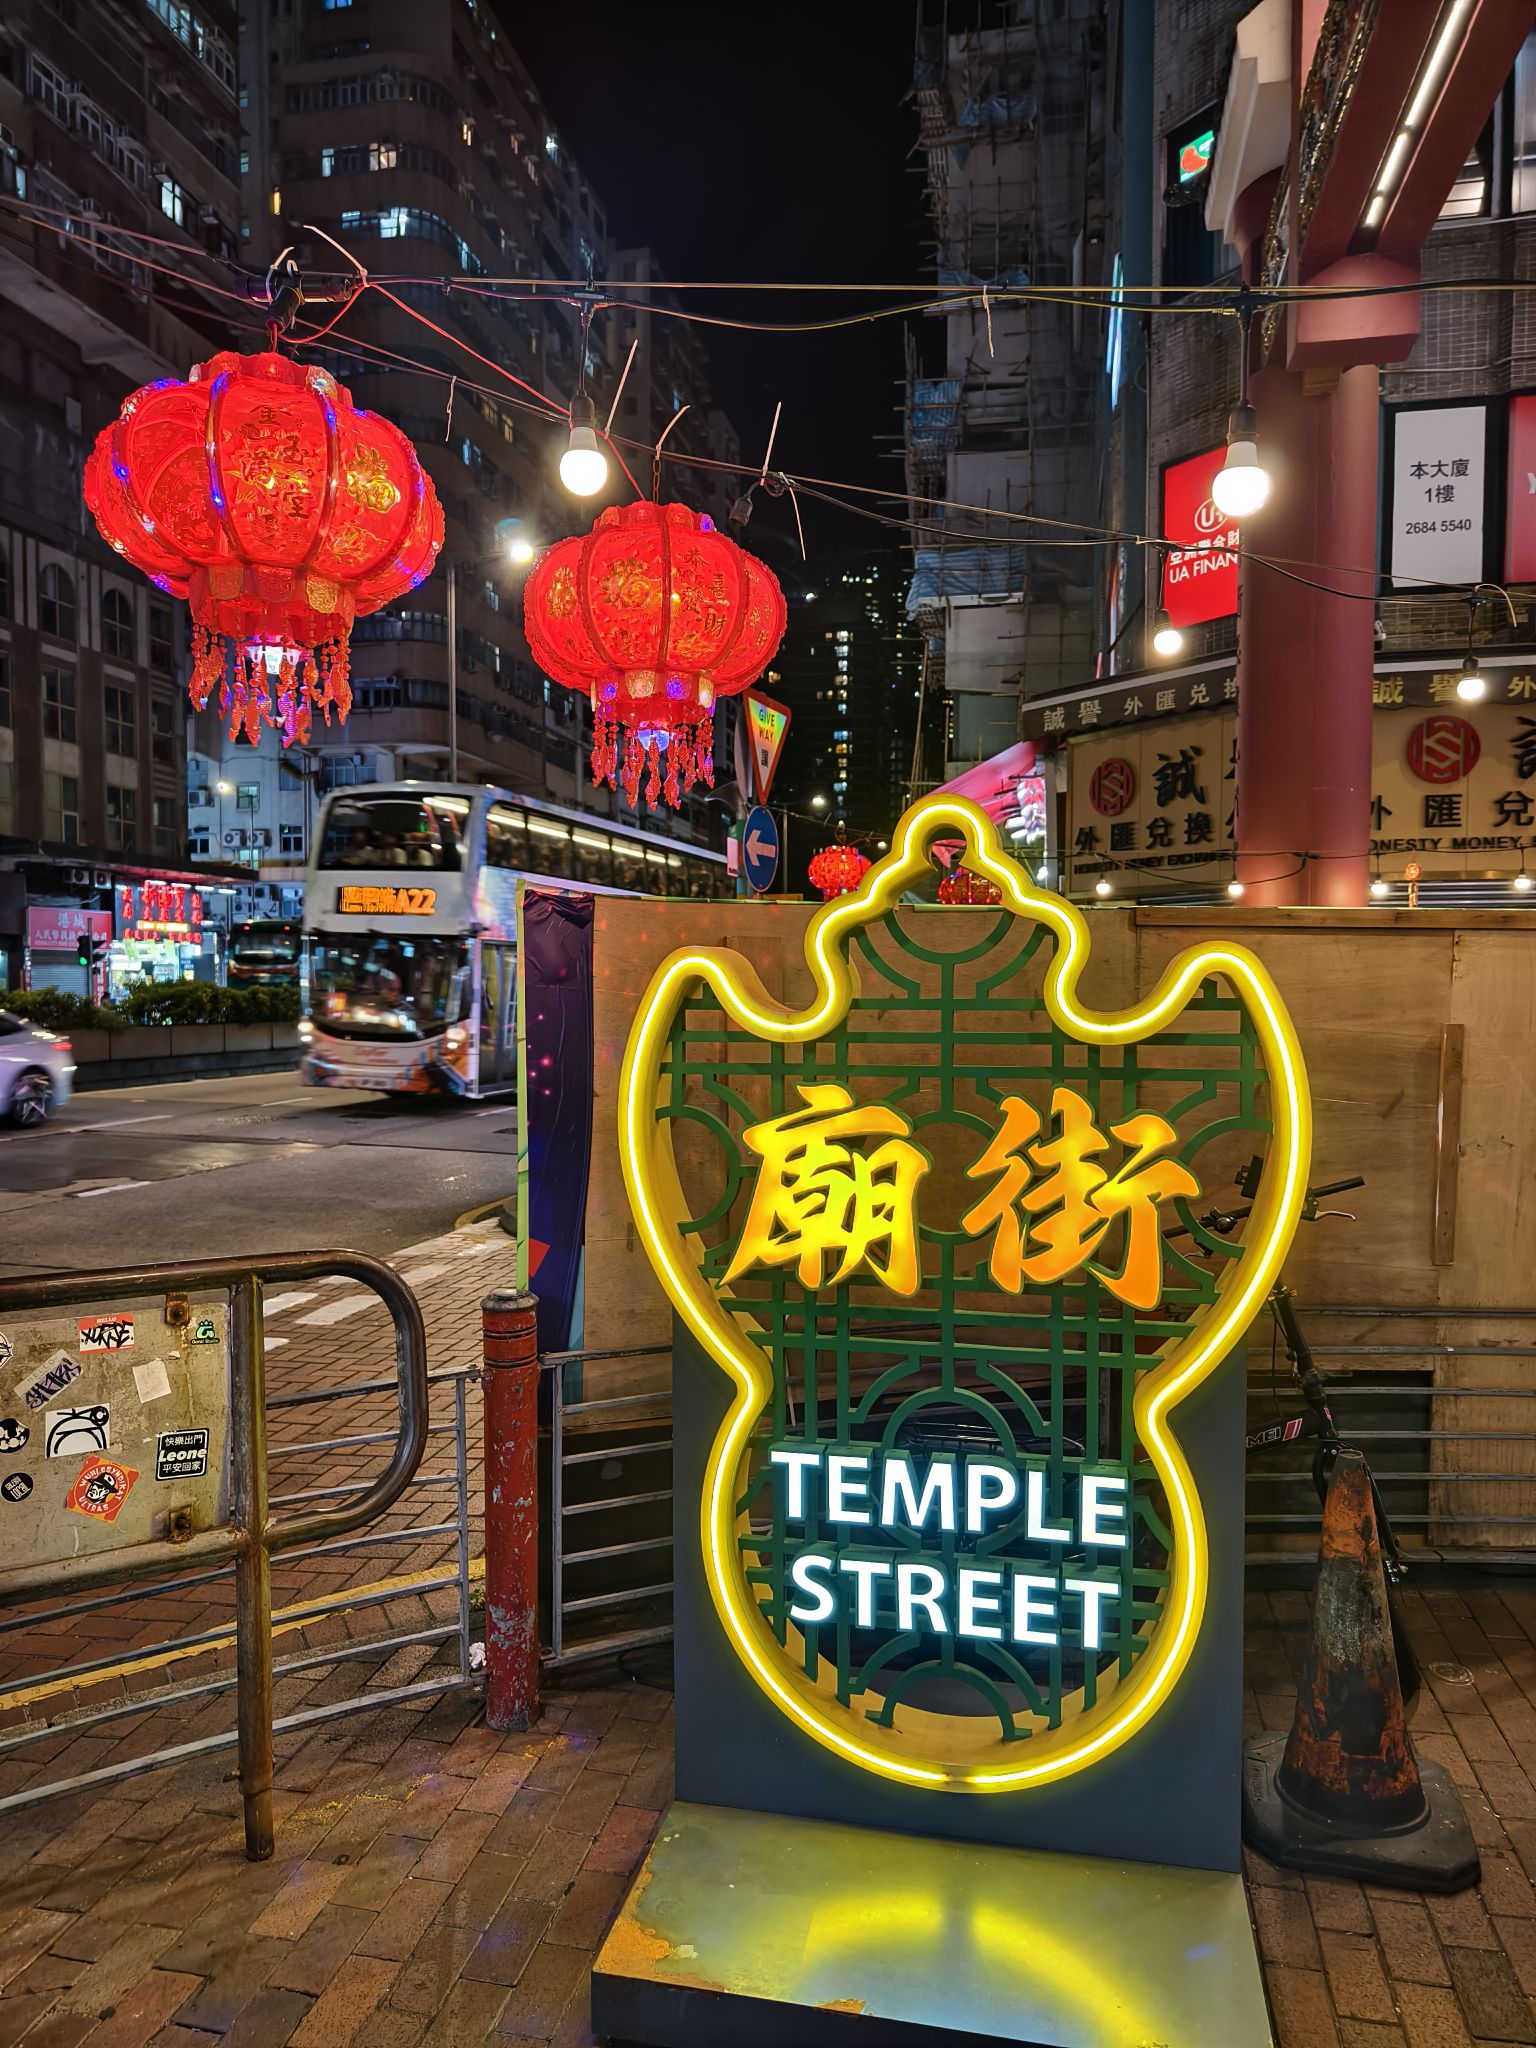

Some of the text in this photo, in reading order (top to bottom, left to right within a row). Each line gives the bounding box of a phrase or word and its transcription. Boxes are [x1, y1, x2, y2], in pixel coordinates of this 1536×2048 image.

[1410, 458, 1470, 479] 本大廈
[1425, 484, 1455, 503] 1樓
[1406, 518, 1472, 535] 2684 5540
[1169, 565, 1190, 584] UA
[759, 708, 775, 727] GIVE
[758, 724, 774, 743] WAY
[1370, 837, 1441, 851] ONESTY
[1452, 835, 1522, 850] MONEY
[396, 887, 436, 914] A22
[719, 1083, 1200, 1310] 廟街
[164, 1433, 203, 1447] 快樂出門
[158, 1448, 207, 1462] Leone
[162, 1460, 201, 1474] 平安回家
[79, 1496, 109, 1512] ULTRAS
[770, 1449, 1128, 1548] TEMPLE
[790, 1553, 1119, 1649] STREET
